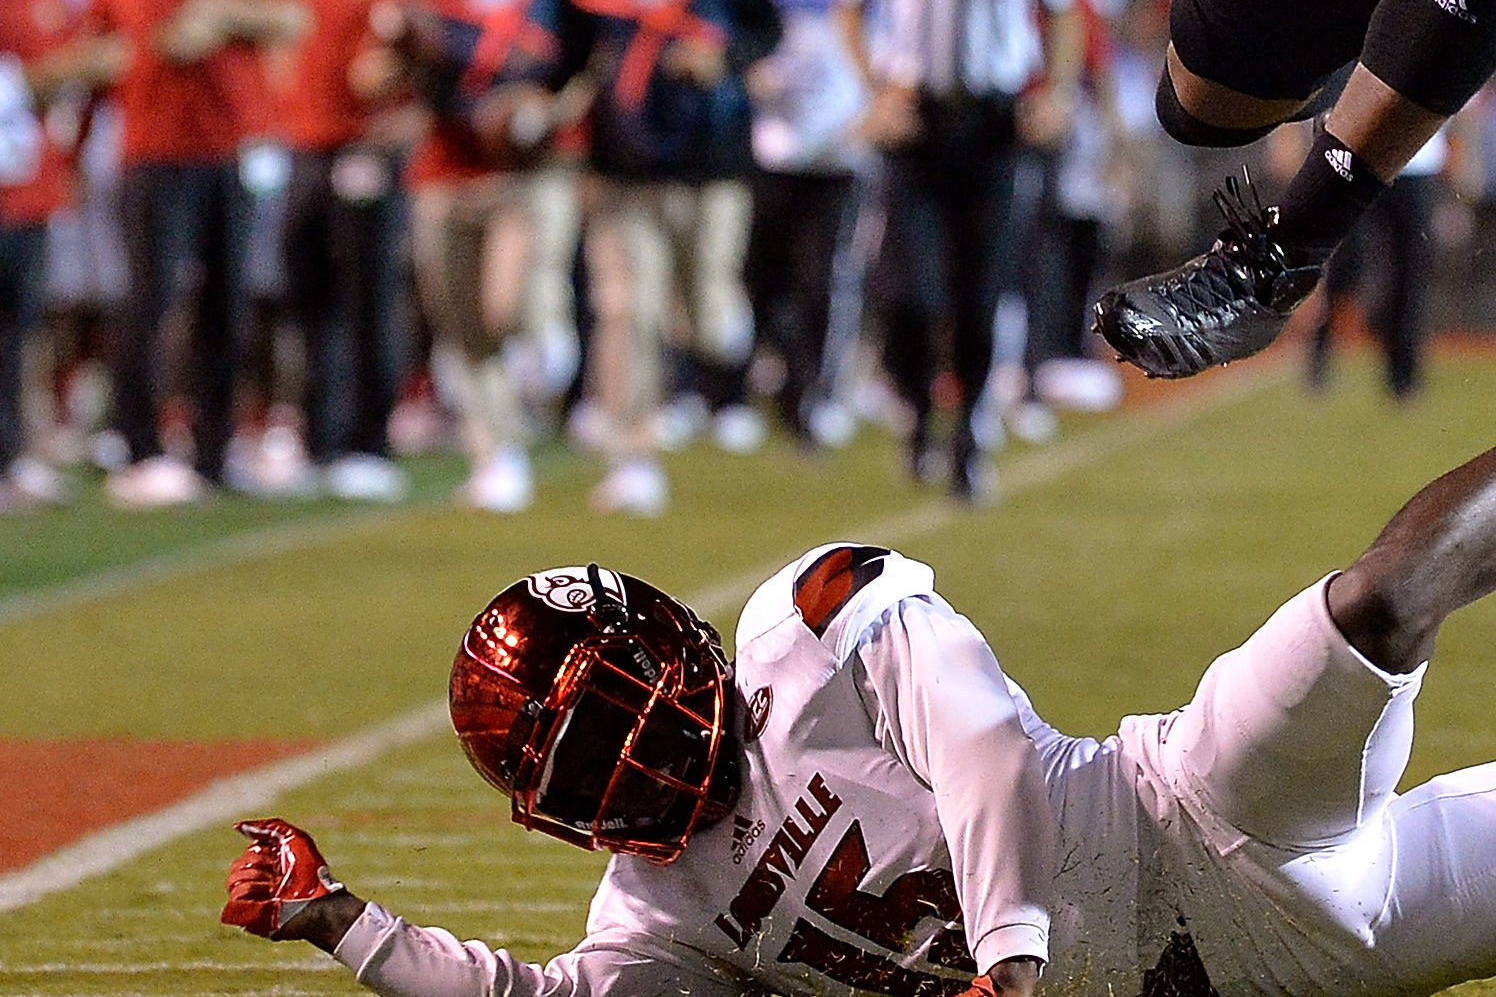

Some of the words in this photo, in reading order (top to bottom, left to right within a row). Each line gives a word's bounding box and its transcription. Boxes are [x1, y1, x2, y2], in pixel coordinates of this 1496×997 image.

[714, 771, 843, 951] LOUISVILLE
[732, 819, 766, 865] adidas
[776, 818, 979, 997] 15
